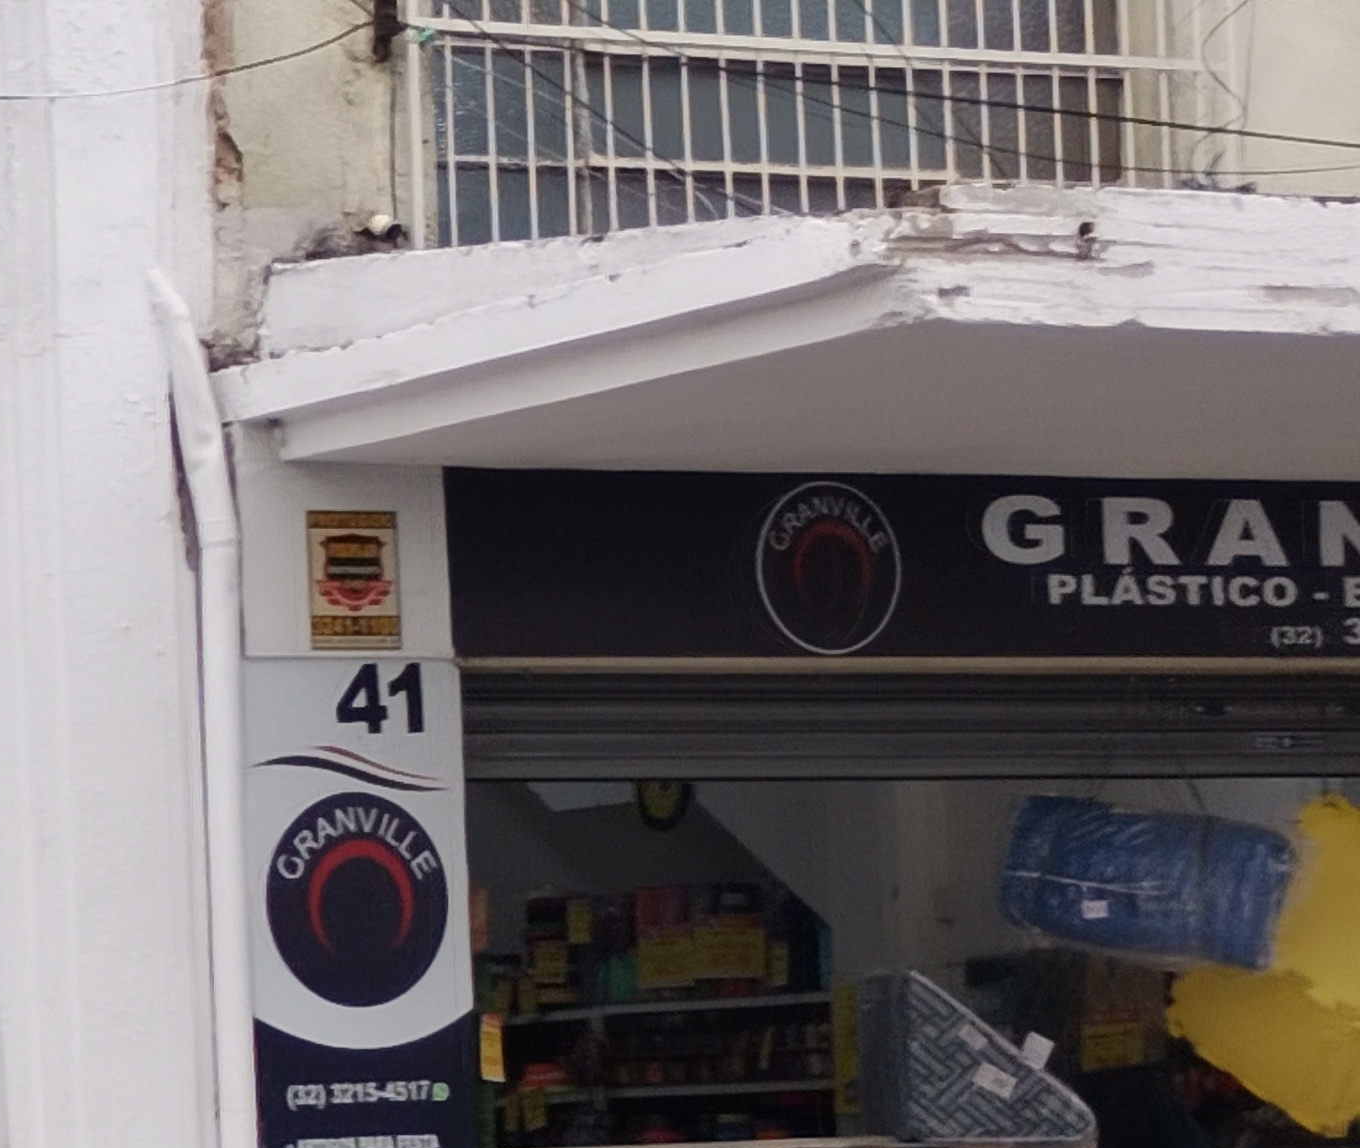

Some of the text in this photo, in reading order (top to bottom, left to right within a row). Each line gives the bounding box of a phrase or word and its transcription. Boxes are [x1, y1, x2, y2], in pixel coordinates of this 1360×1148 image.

[769, 496, 889, 552] GRANVILLE
[1047, 566, 1298, 608] PLÁSTICO
[1269, 625, 1323, 649] (32)
[336, 662, 424, 734] 41
[277, 806, 437, 880] GRANVILLE
[286, 1079, 431, 1111] (32) 3215-4517
